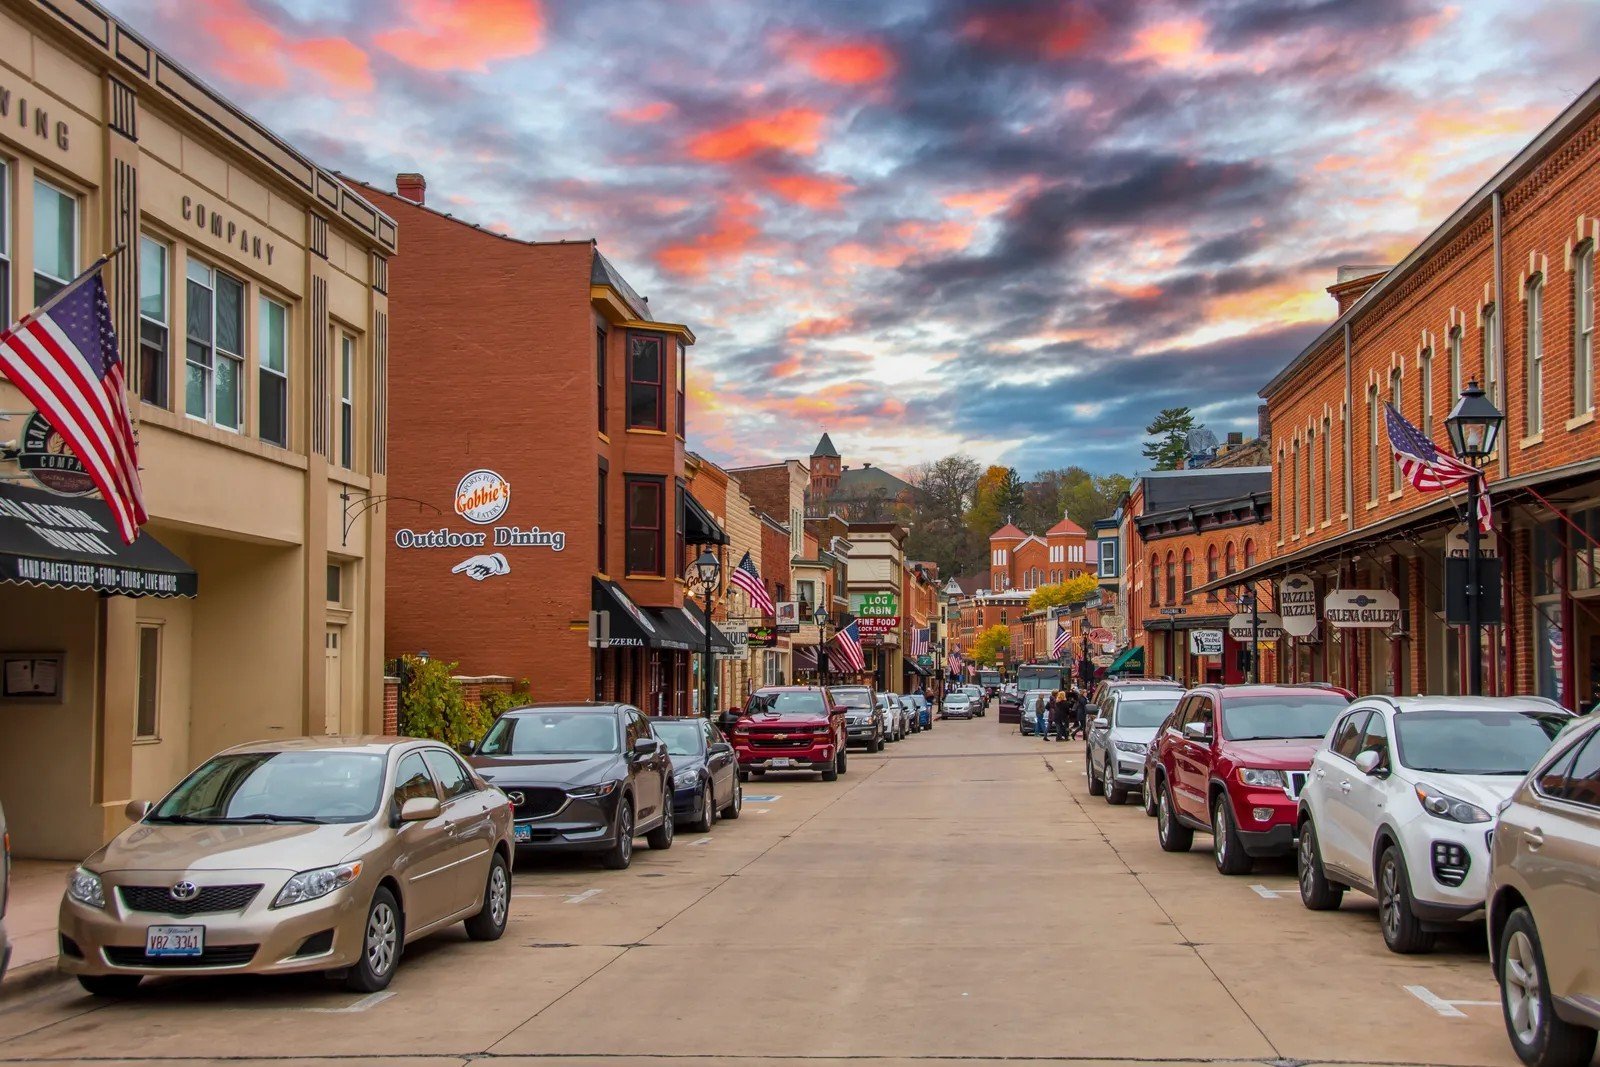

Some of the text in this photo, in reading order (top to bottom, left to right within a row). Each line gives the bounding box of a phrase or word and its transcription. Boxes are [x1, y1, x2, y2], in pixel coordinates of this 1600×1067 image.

[182, 195, 274, 266] COMPANY
[27, 420, 50, 448] GAL
[40, 456, 87, 472] COMPA
[463, 475, 496, 494] SPORTS PUB
[457, 481, 508, 513] Gobbie's
[21, 501, 109, 533] BREWING
[476, 504, 501, 519] EATERY
[26, 523, 118, 556] COMPANY
[396, 527, 564, 550] Outdoor Dining
[17, 559, 177, 592] HAND CRAFTED BEERS FOOD TOURS LIVE MUSIC
[869, 596, 888, 605] LOG
[1281, 591, 1314, 604] RAZZLE
[863, 606, 892, 615] CABIN
[1282, 605, 1315, 617] DAZZLE
[1326, 609, 1401, 622] GALENA GALLERY
[857, 618, 896, 626] FINE FOOD
[1231, 628, 1265, 638] SPECIATY
[609, 638, 644, 646] ZZERIA
[175, 936, 199, 950] 3341
